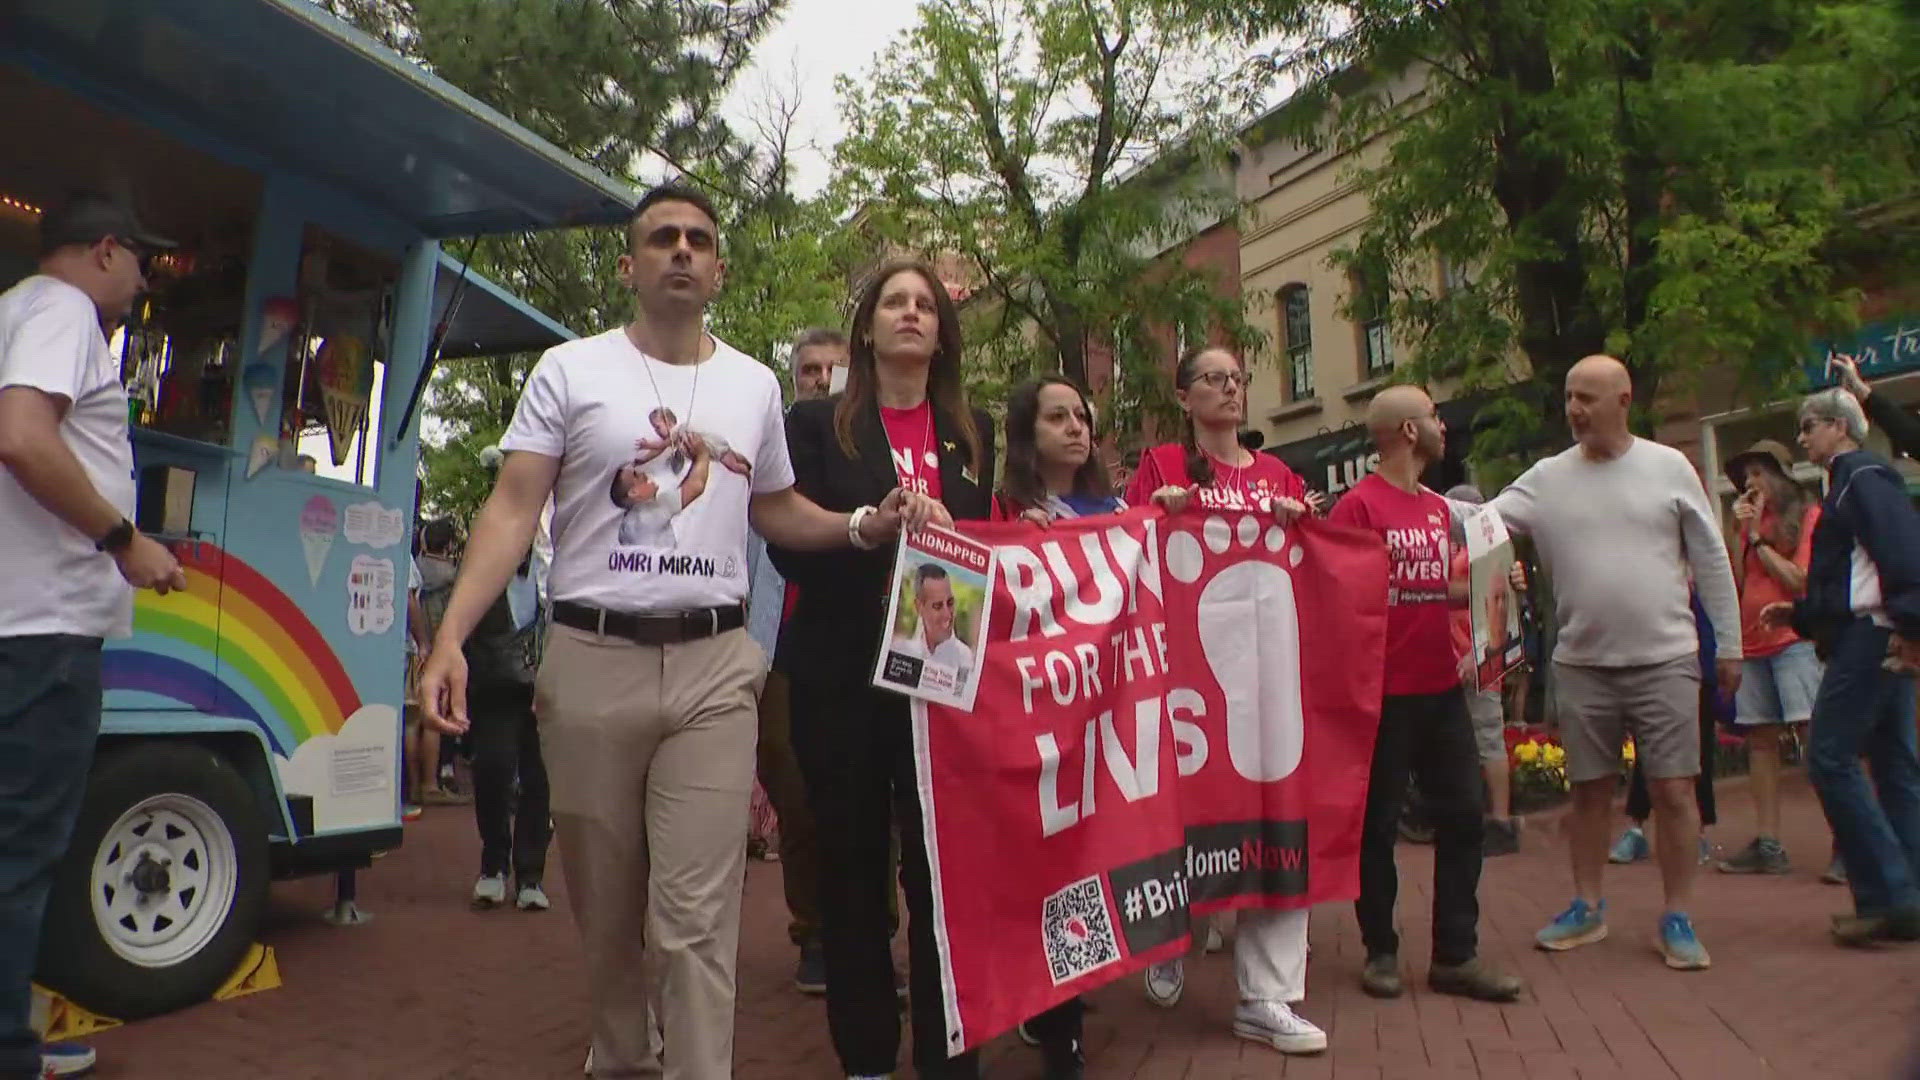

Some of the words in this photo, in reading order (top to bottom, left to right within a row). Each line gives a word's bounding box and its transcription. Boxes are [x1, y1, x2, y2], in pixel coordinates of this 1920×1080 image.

[1200, 486, 1246, 506] RUN
[911, 531, 986, 568] KIDNAPPED
[1387, 528, 1428, 550] RUN
[608, 551, 652, 573] OMRI
[658, 554, 715, 578] MIRAN
[1389, 560, 1441, 581] IVES
[997, 518, 1164, 643] RUN
[1016, 642, 1103, 714] FOR
